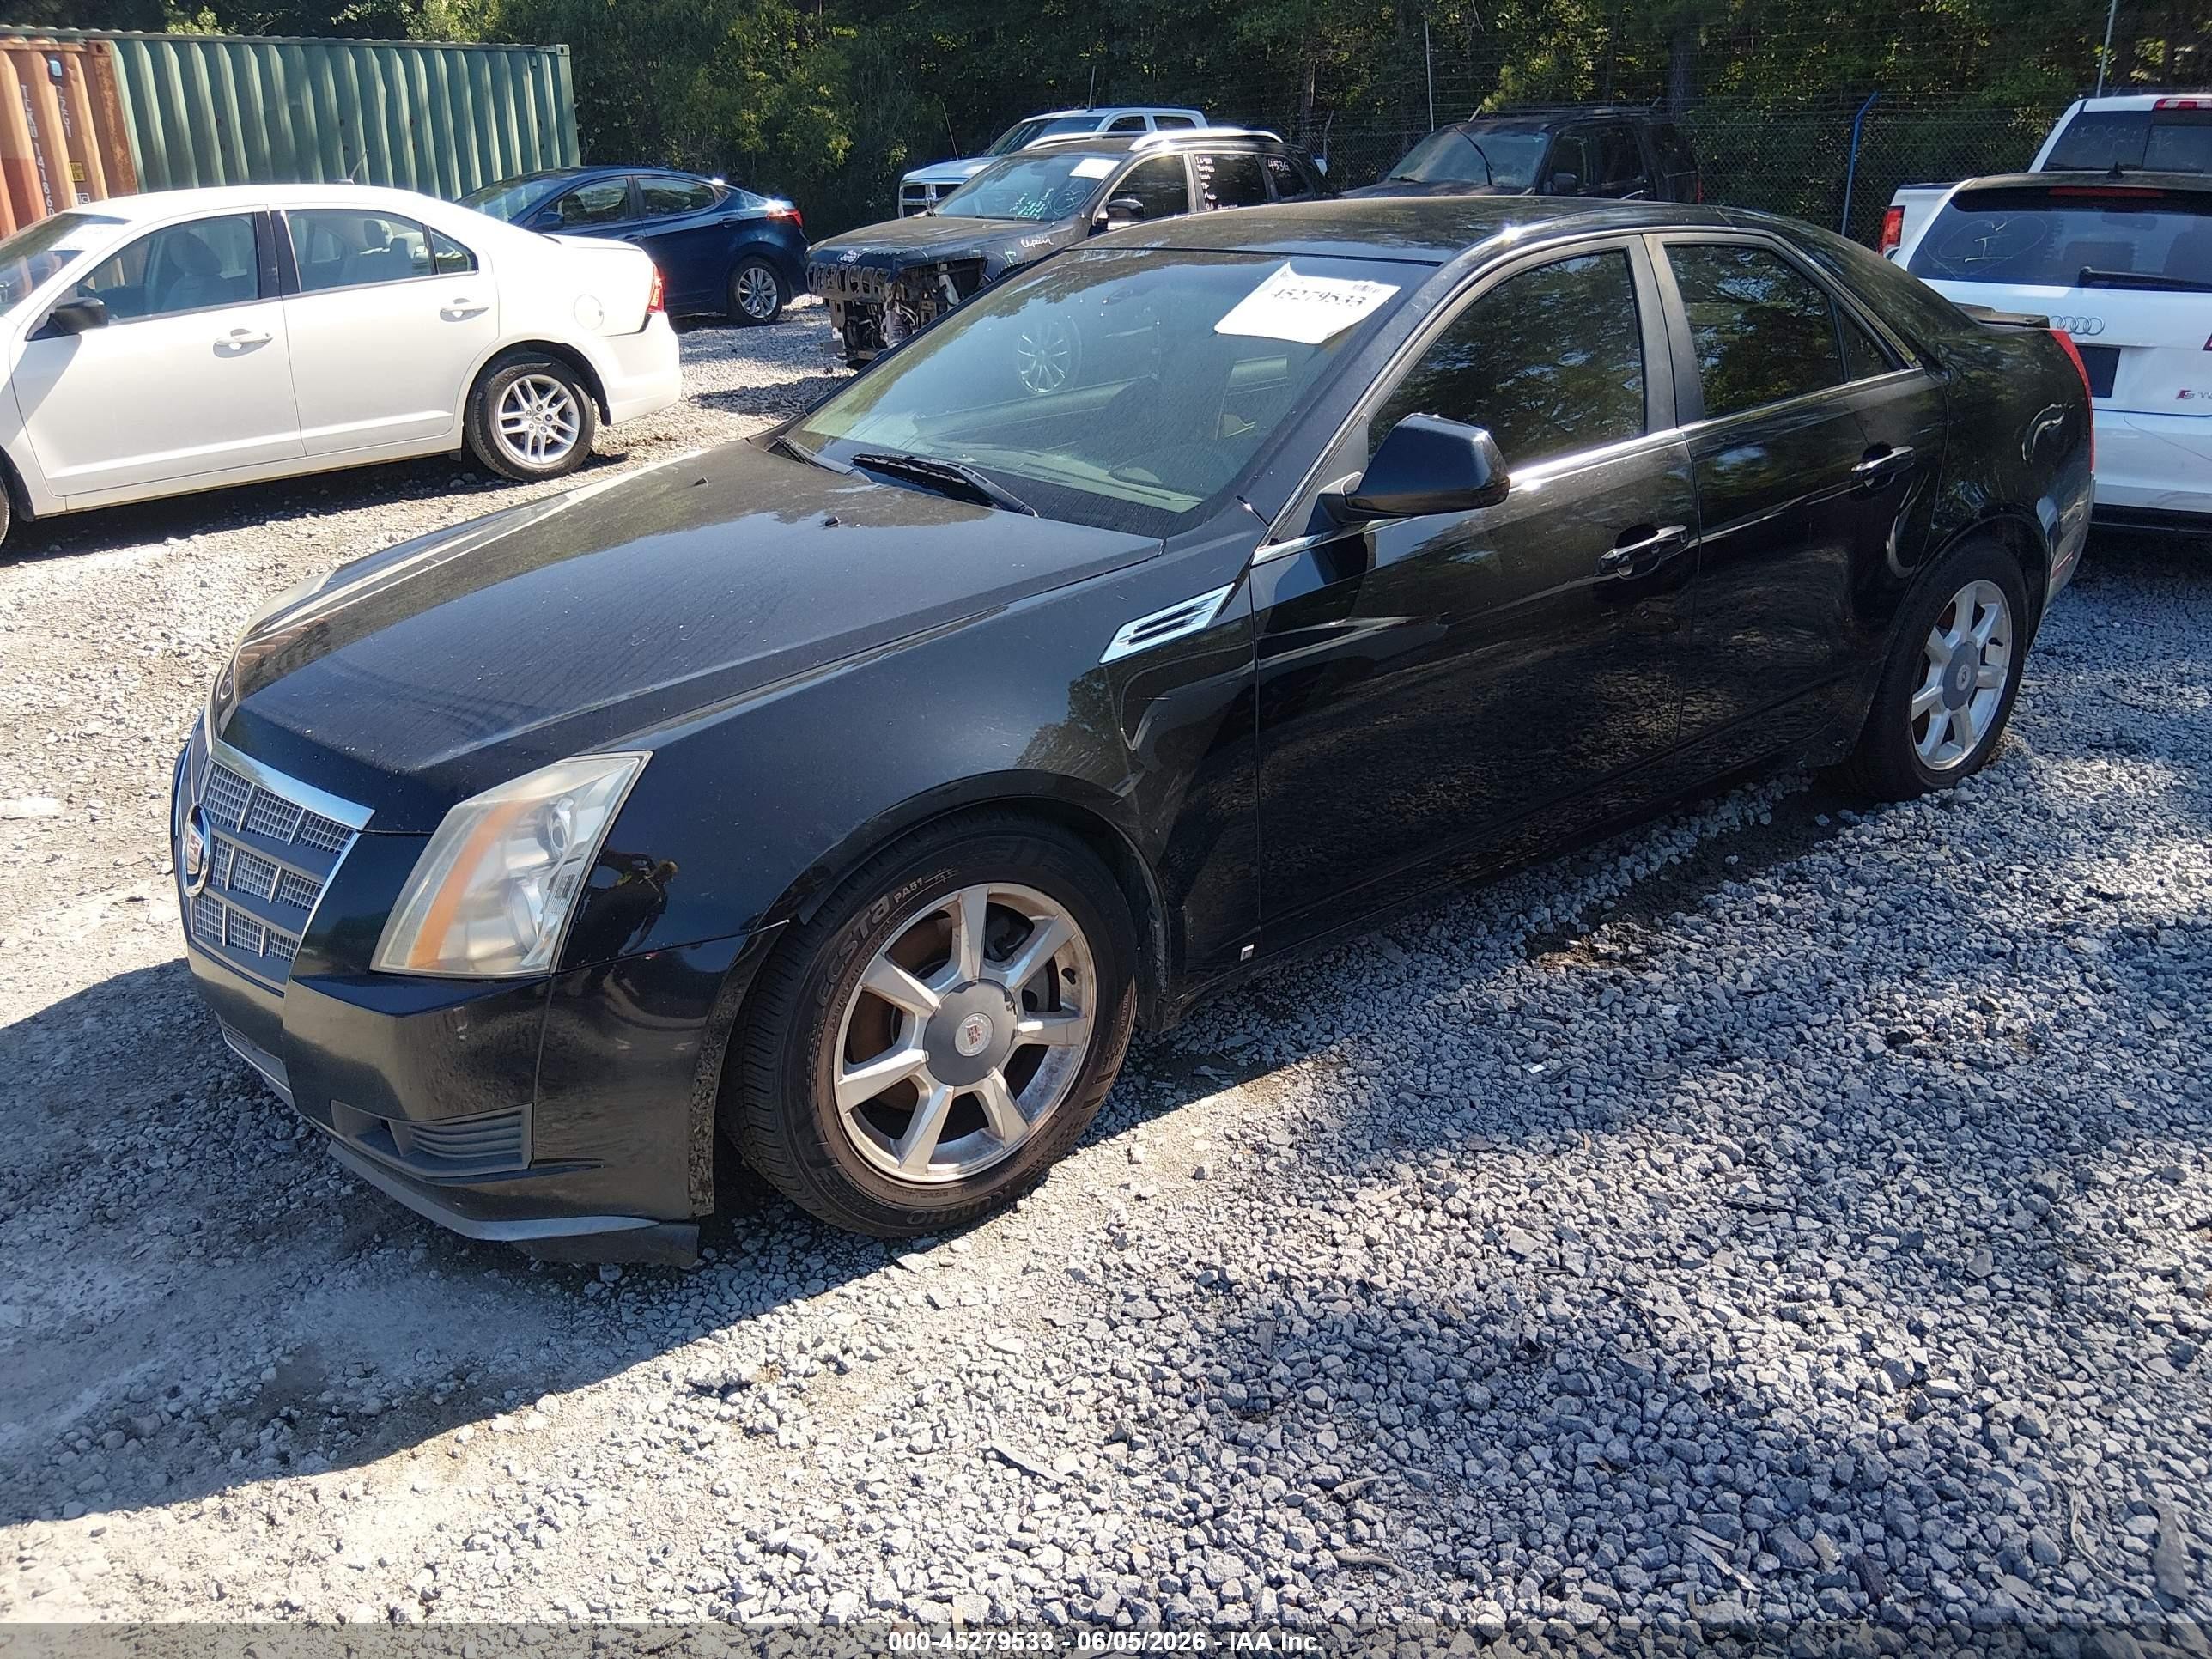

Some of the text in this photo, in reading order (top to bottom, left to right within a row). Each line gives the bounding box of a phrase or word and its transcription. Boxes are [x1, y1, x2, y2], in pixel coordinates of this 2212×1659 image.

[20, 84, 40, 138] TCKU
[1271, 288, 1367, 308] 45279533
[893, 877, 923, 904] PA51
